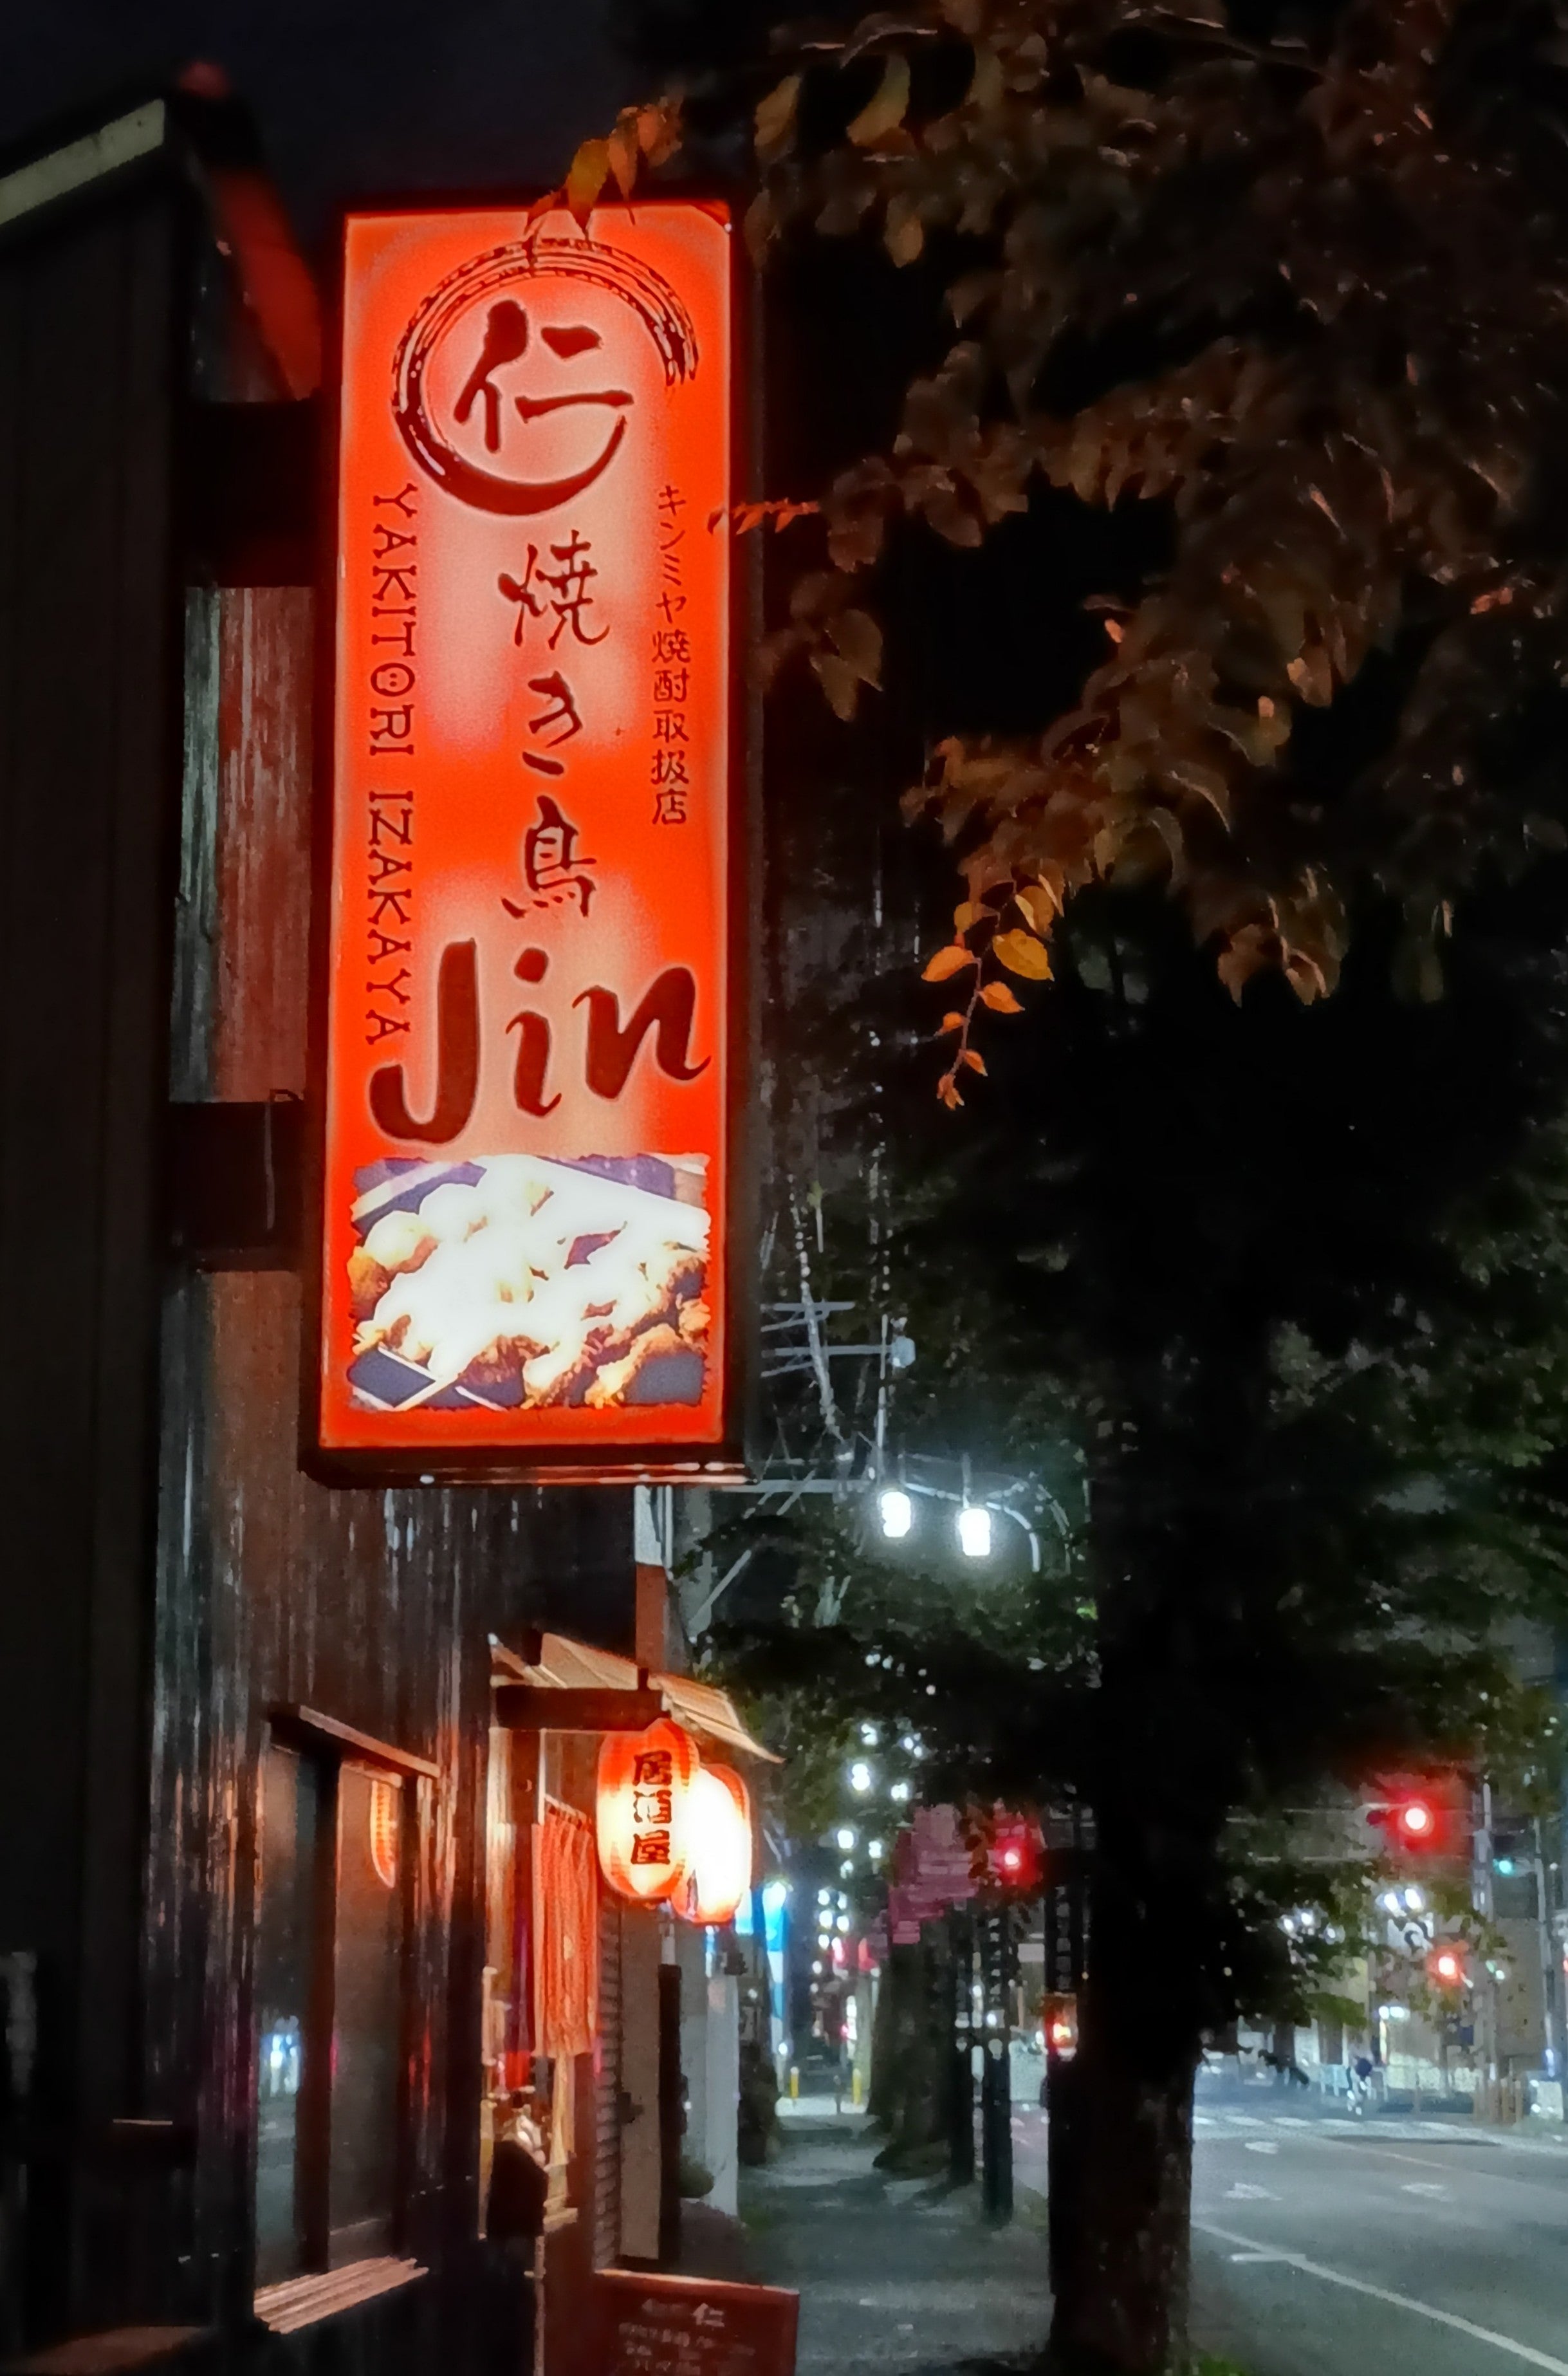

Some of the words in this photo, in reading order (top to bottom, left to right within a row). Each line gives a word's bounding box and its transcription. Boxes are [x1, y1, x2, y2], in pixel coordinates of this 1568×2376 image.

[454, 299, 634, 452] 仁
[370, 483, 418, 756] YAKITORI
[497, 529, 611, 919] 焼き鳥
[650, 485, 692, 826] キンミヤ焼酎取扱店
[365, 790, 414, 1045] IZAKAYA
[369, 937, 711, 1145] Jin
